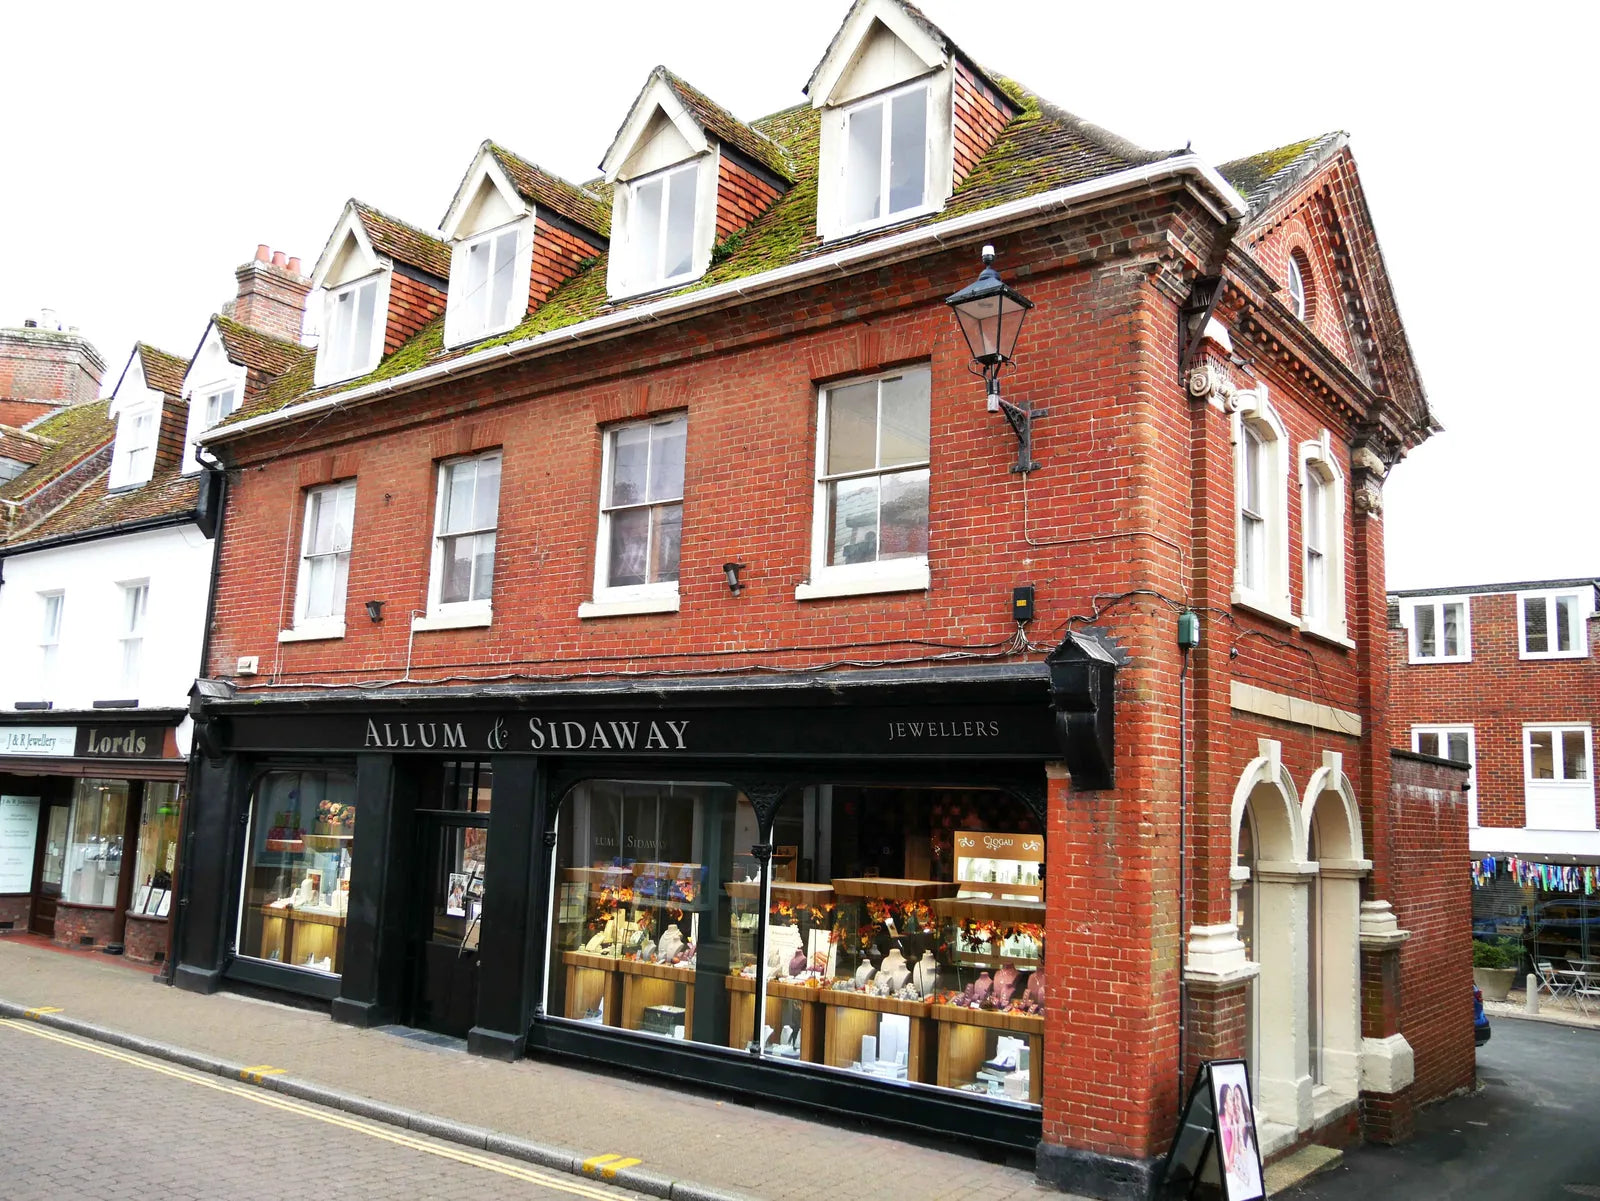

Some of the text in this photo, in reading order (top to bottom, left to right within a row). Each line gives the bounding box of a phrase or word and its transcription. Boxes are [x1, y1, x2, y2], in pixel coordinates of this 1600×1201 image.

[87, 729, 147, 753] Lords
[364, 717, 690, 750] ALLUM & SIDAWAY
[888, 721, 999, 740] JEWELLERS
[20, 733, 26, 746] R
[25, 733, 56, 751] Jewellery
